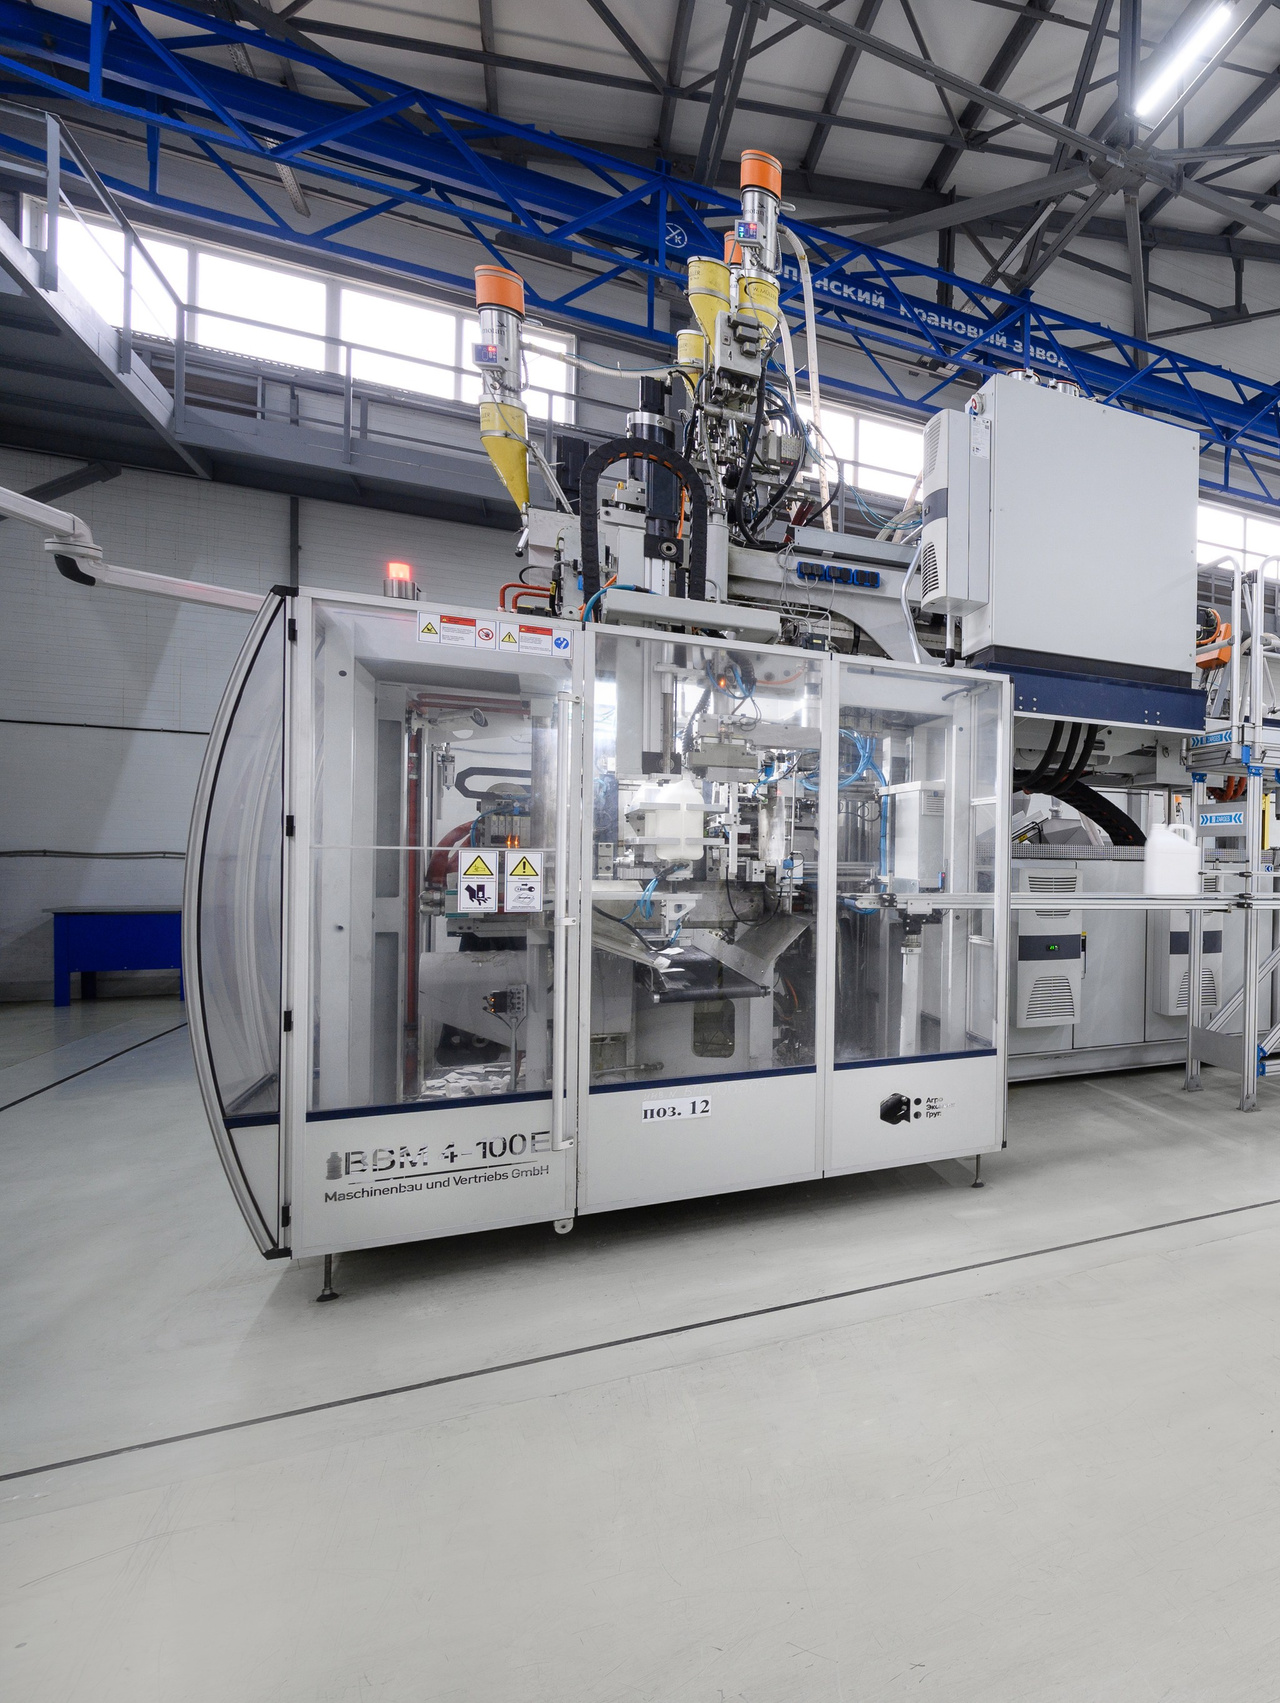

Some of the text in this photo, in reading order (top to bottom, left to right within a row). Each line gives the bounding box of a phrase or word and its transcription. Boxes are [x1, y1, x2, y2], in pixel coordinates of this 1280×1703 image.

[643, 1099, 710, 1119] поз. 12
[345, 1145, 429, 1176] BBM
[325, 1165, 550, 1203] Maschinenbau und Vertriebs GmbH
